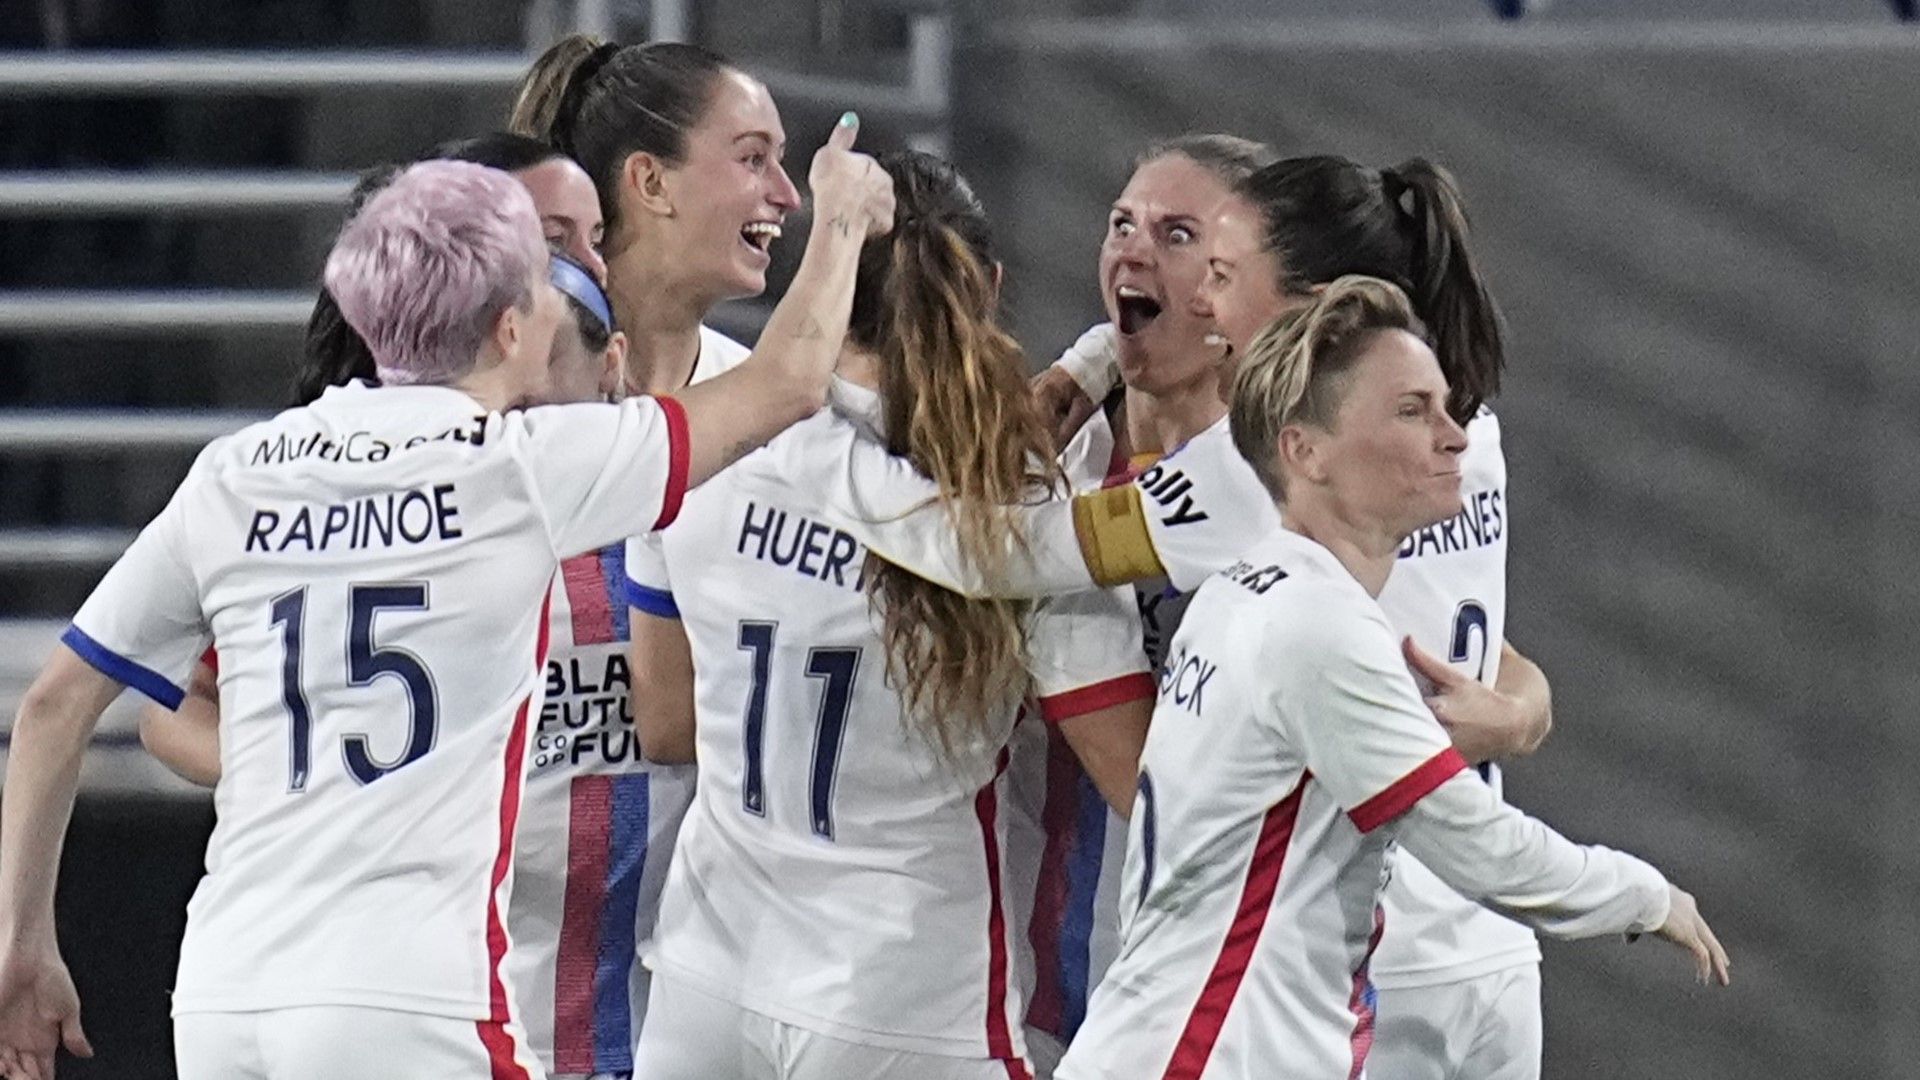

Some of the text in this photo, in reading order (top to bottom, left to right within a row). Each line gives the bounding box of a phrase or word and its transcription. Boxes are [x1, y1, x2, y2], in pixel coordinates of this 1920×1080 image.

[245, 484, 463, 552] RAPINOE
[251, 431, 427, 466] MultiCa
[267, 581, 440, 794] 15
[737, 619, 863, 842] 11
